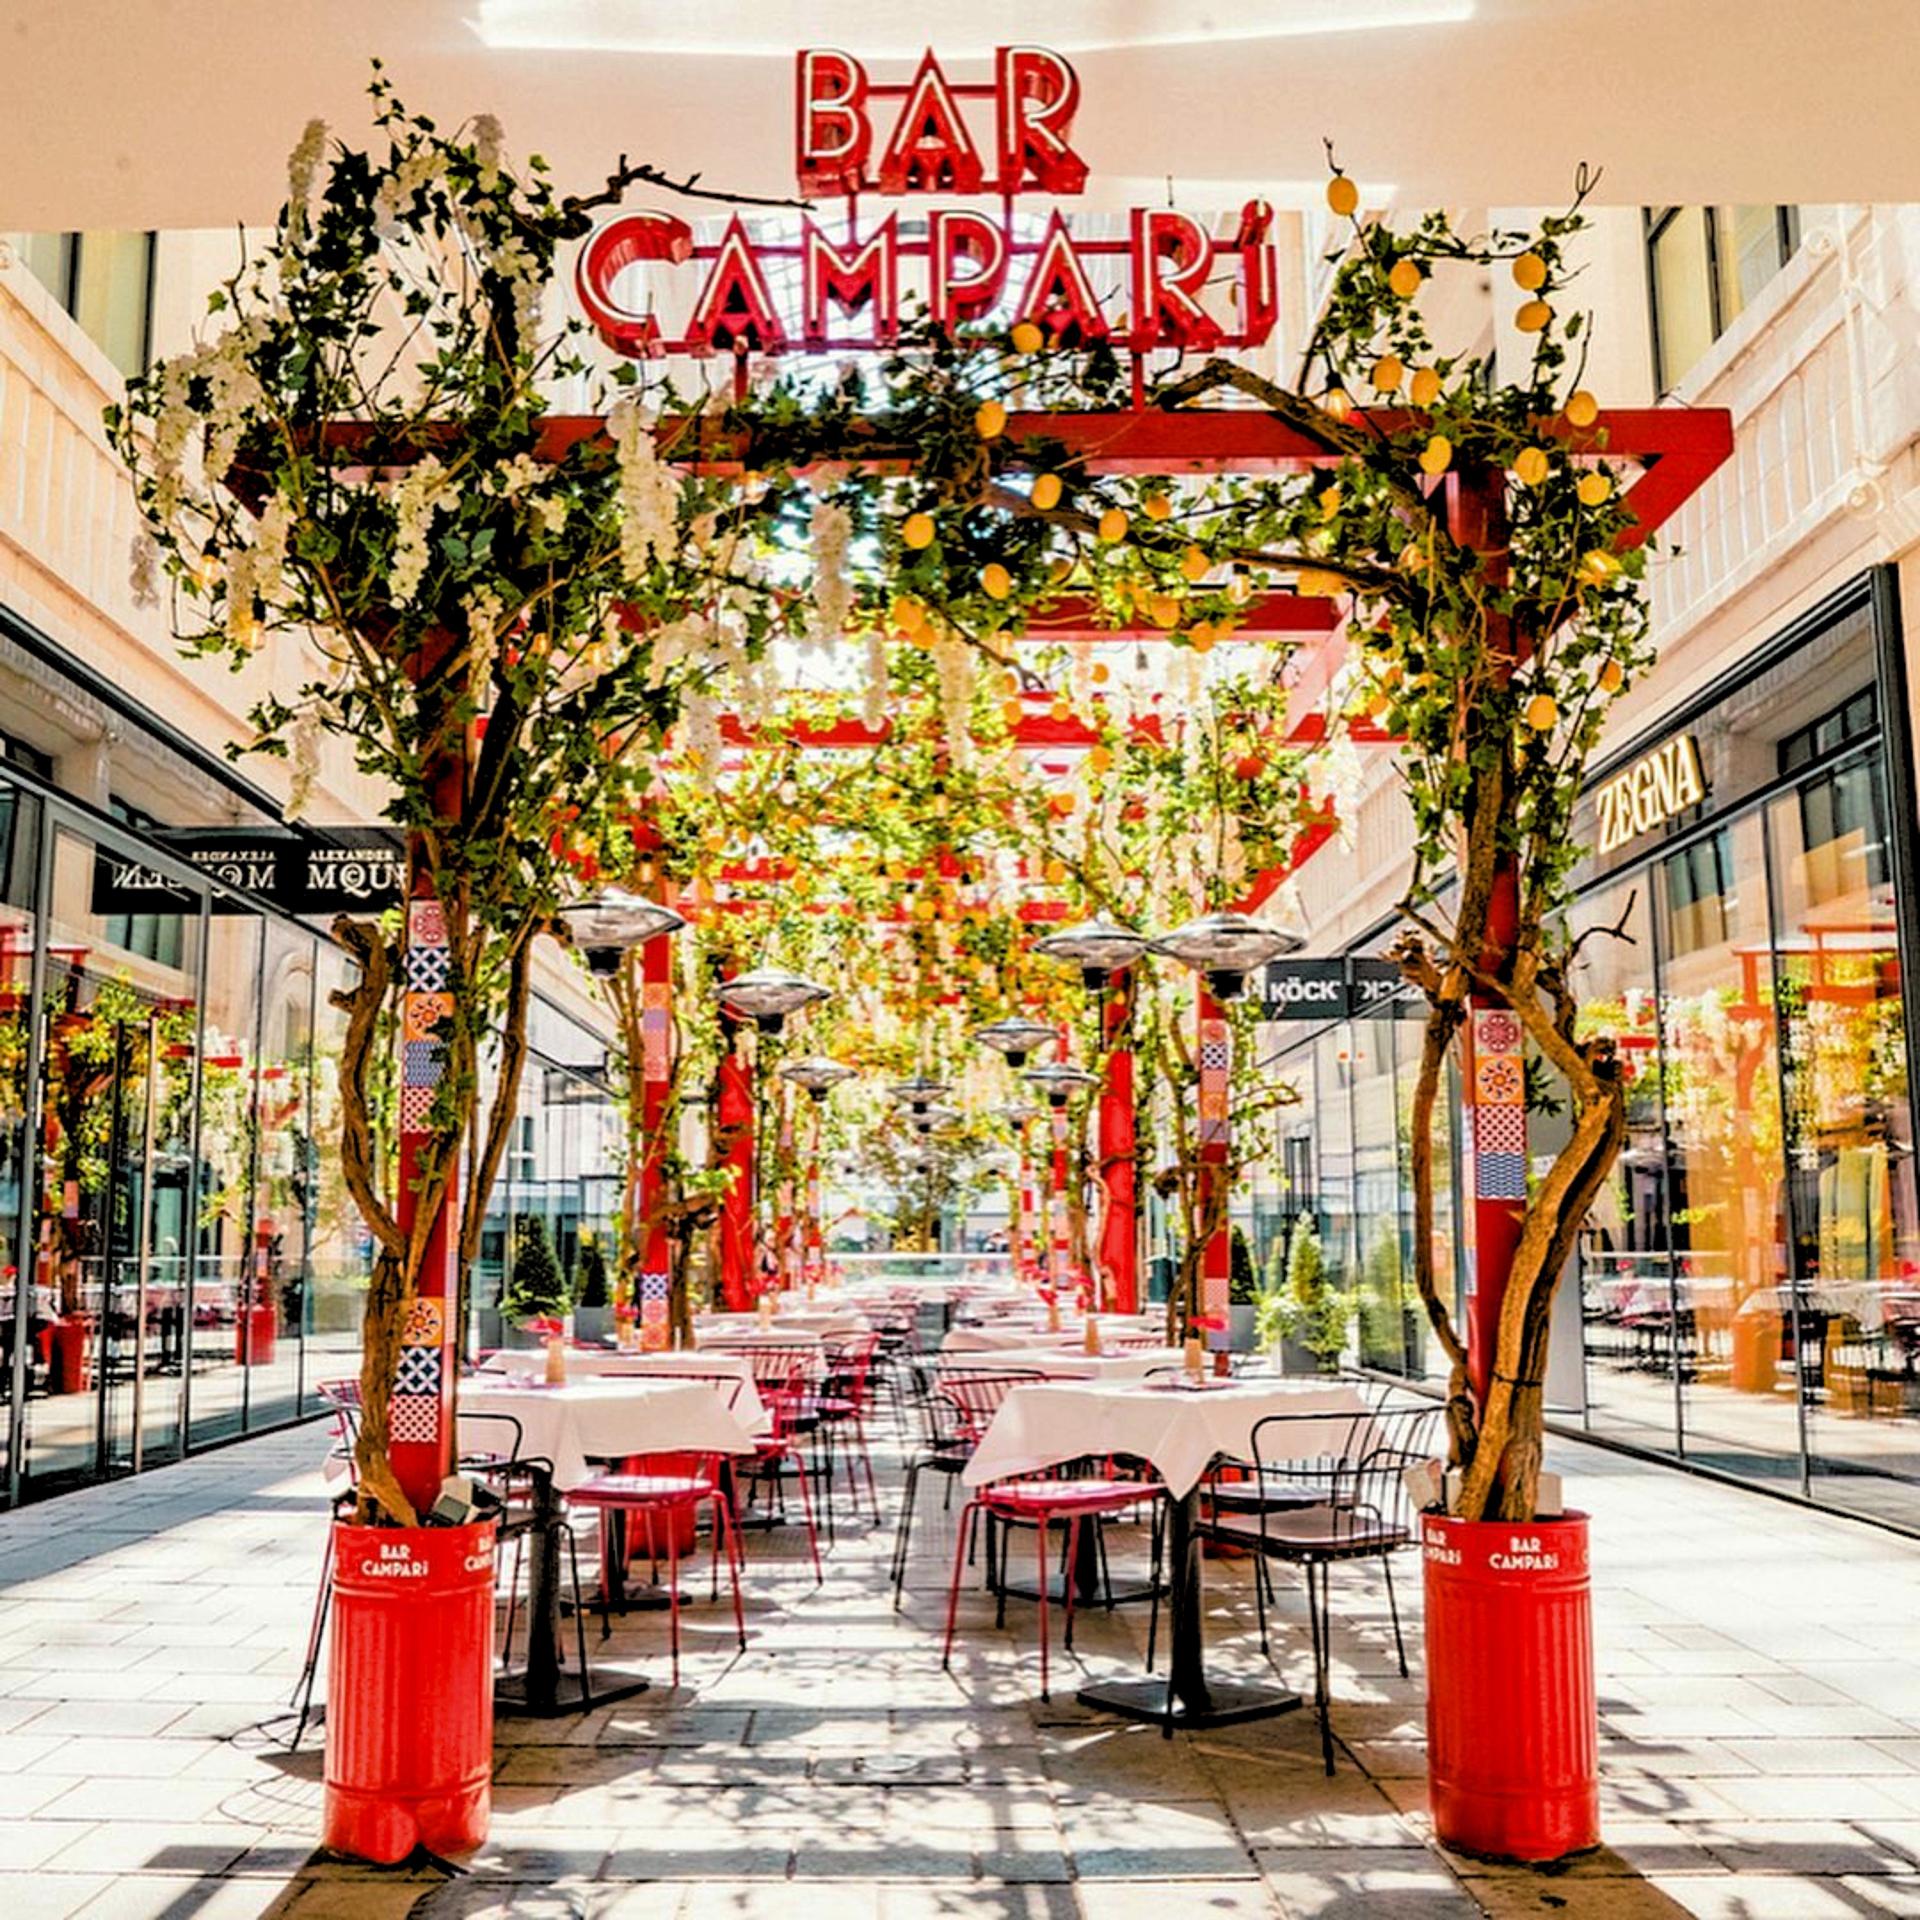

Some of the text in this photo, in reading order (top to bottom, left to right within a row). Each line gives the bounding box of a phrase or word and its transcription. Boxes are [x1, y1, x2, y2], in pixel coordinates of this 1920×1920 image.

[796, 46, 1089, 196] BAR
[1596, 734, 1704, 856] ZEGNA
[308, 849, 395, 862] ALEXANDER
[1269, 975, 1341, 1003] KÖCK
[380, 1544, 411, 1560] BAR
[1509, 1537, 1541, 1553] BAR
